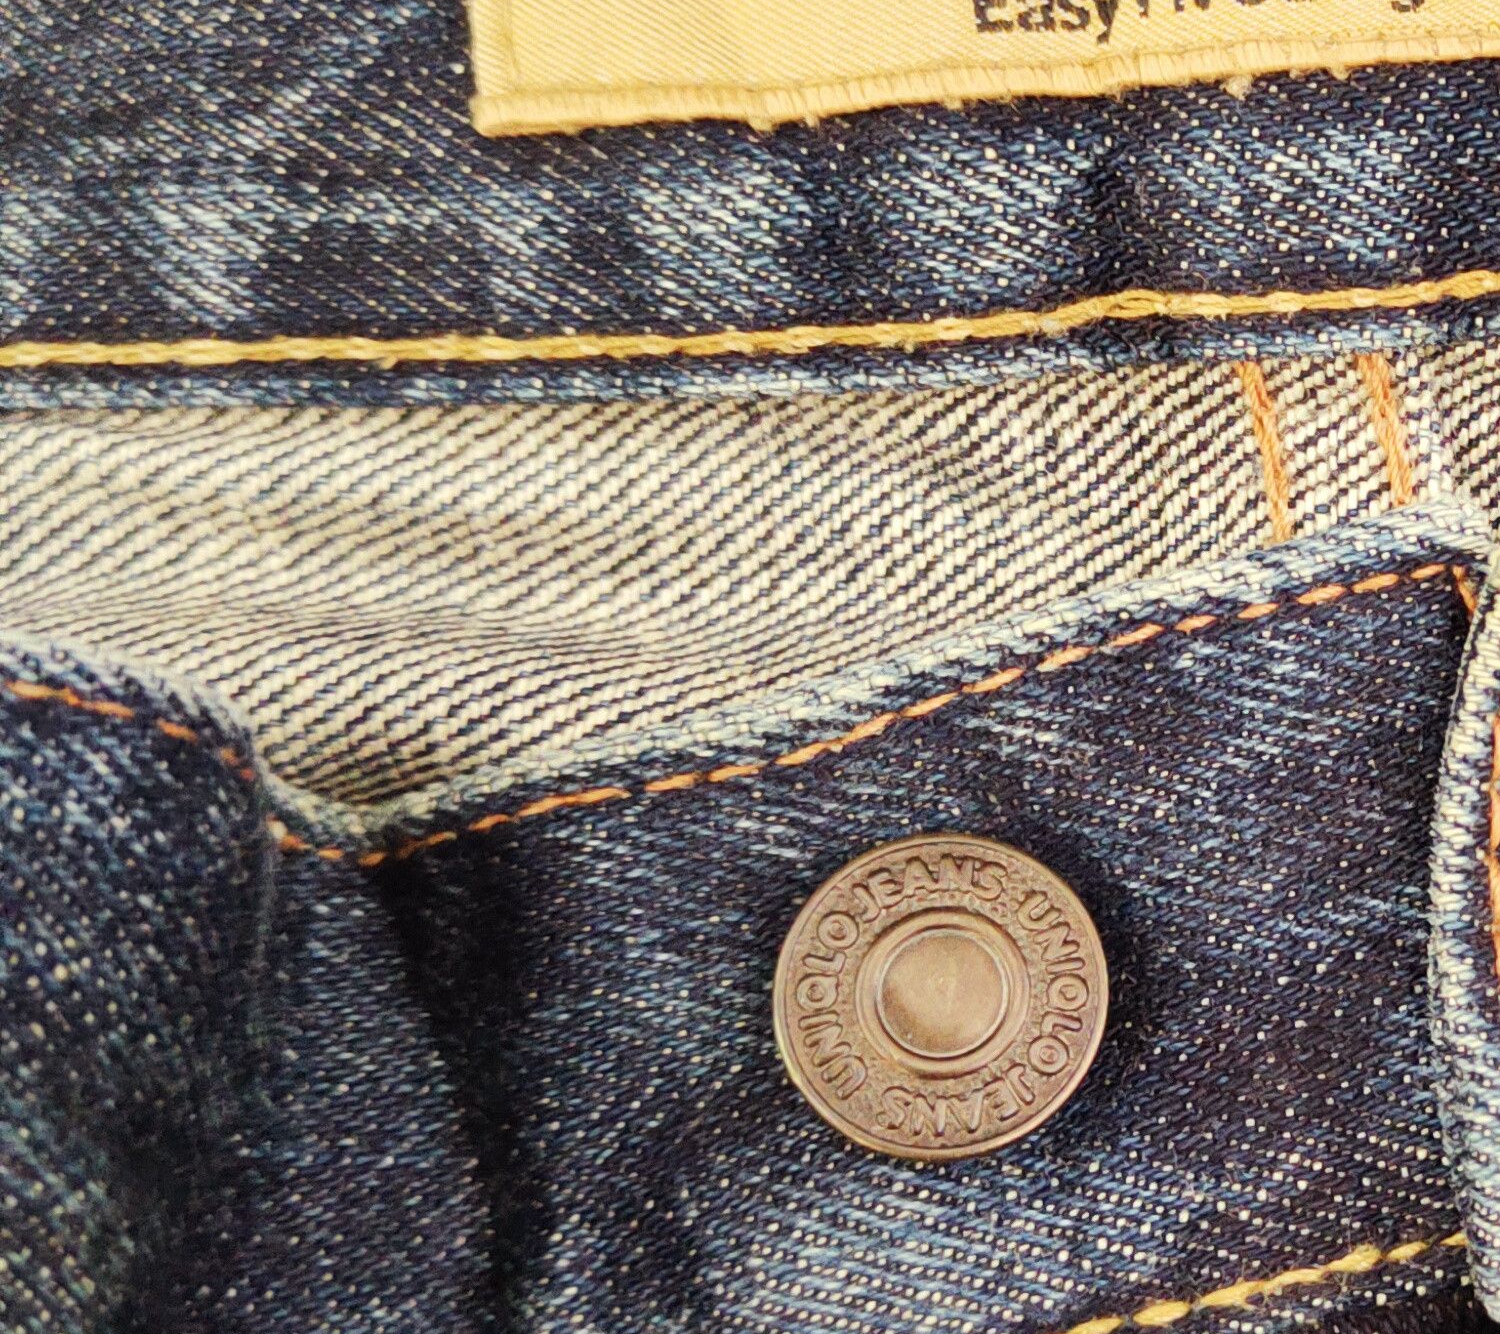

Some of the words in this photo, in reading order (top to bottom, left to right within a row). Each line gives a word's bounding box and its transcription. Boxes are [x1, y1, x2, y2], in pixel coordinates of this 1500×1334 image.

[796, 910, 869, 1101] UNIQLO
[852, 854, 1008, 923] JEANS
[876, 1062, 1036, 1138] JEANS
